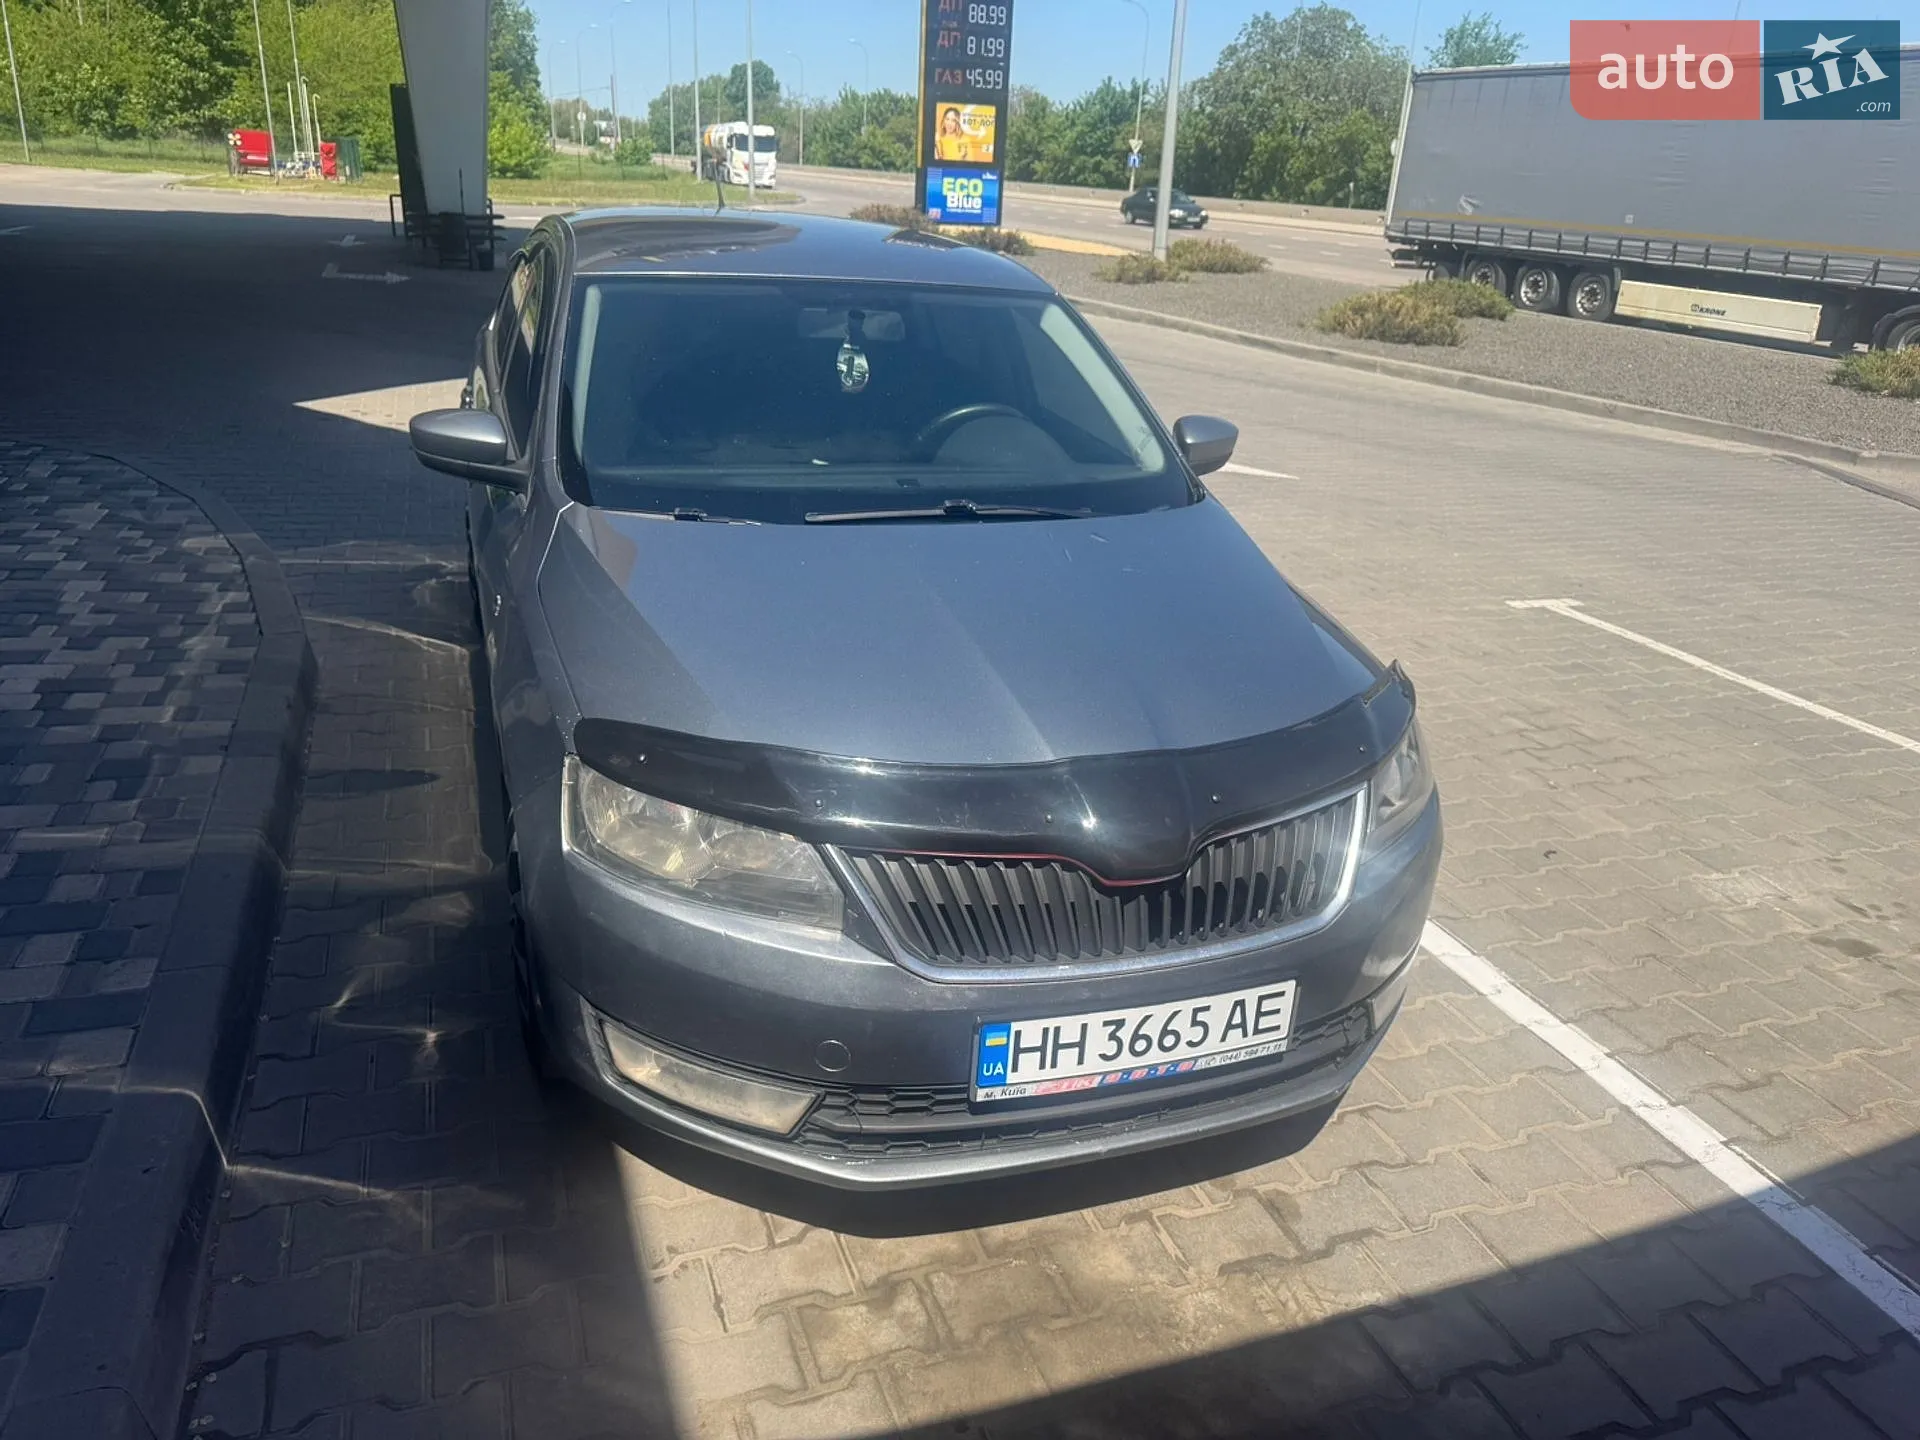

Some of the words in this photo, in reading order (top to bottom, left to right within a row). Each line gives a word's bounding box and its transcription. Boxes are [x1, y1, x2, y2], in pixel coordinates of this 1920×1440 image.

[968, 3, 1007, 26] 88.99
[966, 35, 1005, 58] 81.99
[934, 67, 963, 85] ГАЗ
[966, 68, 1004, 90] 45.99
[942, 177, 983, 197] ECO
[947, 191, 983, 210] Blue
[1011, 1022, 1088, 1073] HH
[1098, 1005, 1212, 1062] 3665
[1219, 990, 1287, 1044] AE
[982, 1062, 1005, 1077] UA
